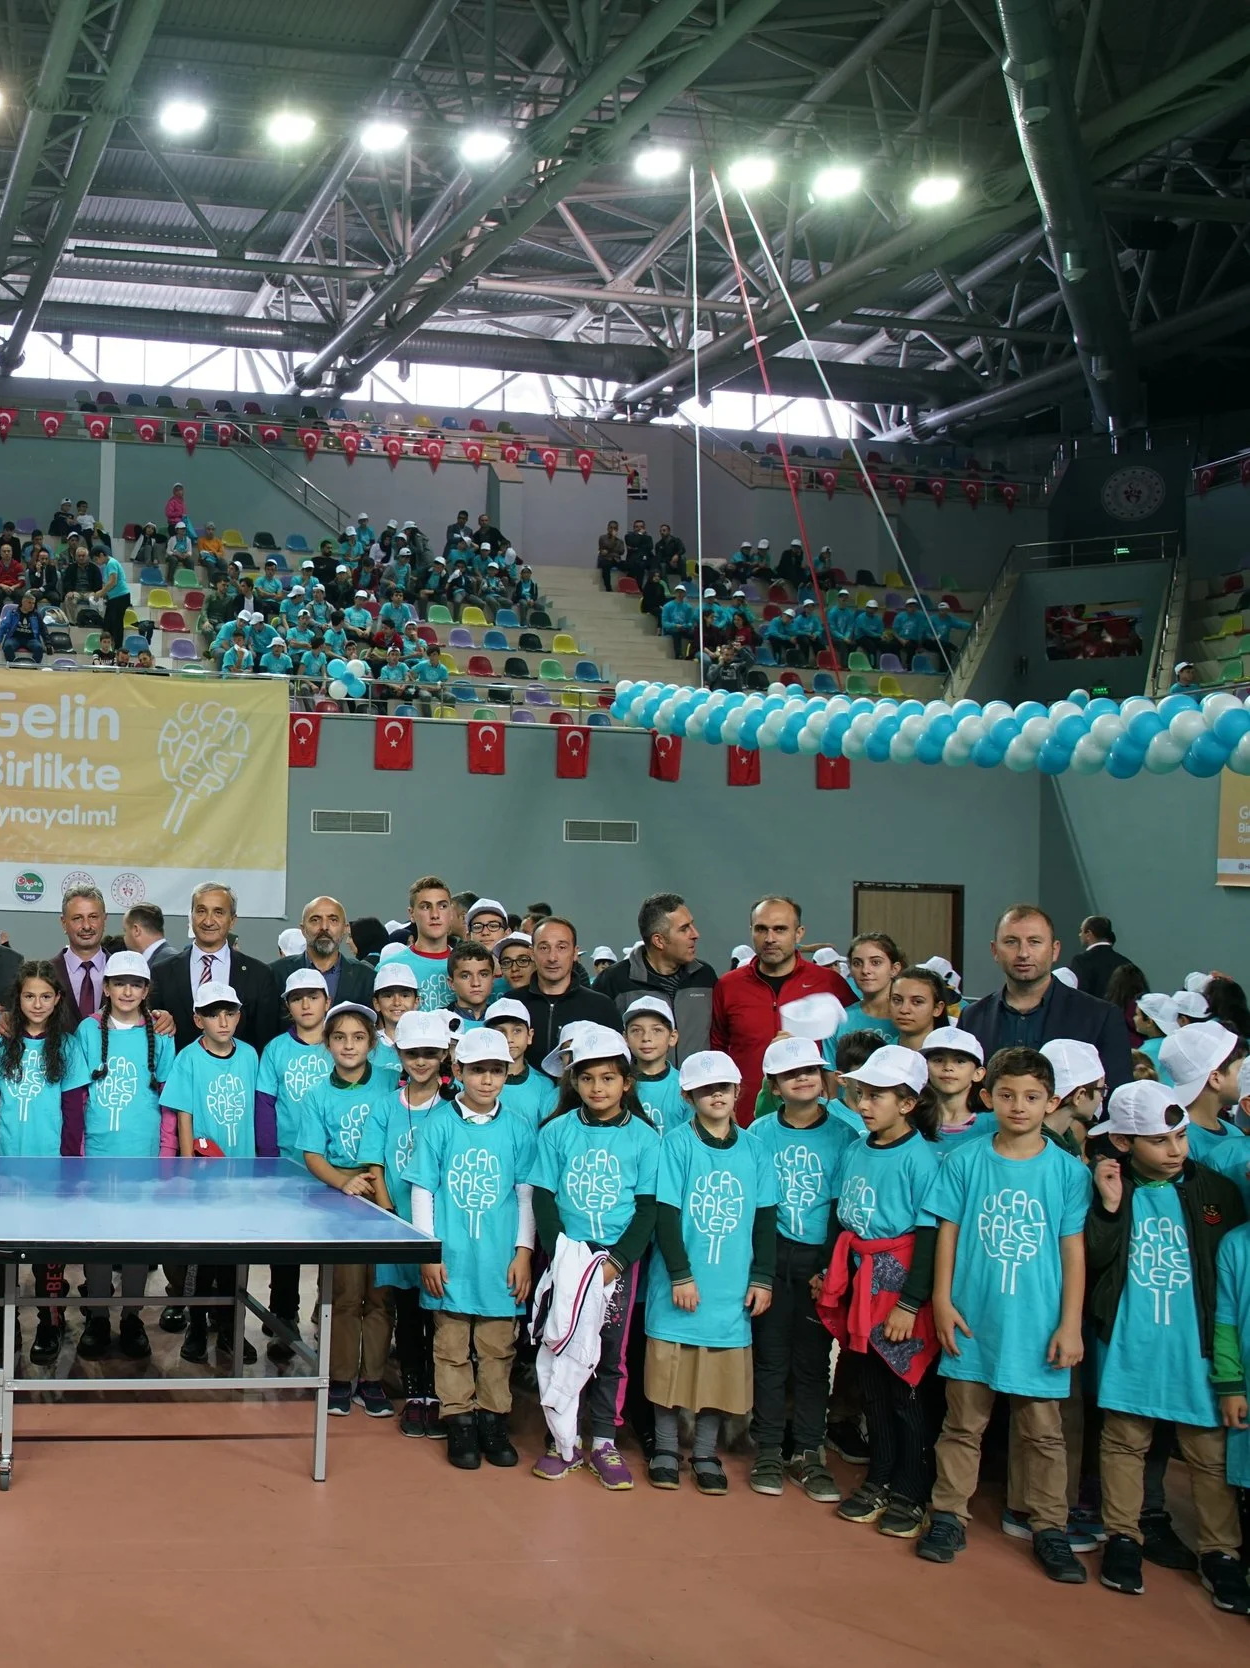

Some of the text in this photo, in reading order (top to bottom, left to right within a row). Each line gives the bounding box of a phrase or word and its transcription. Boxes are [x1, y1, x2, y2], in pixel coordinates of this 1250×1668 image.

[177, 700, 251, 751] UÇAN
[157, 719, 249, 783] RAKET
[288, 1054, 329, 1073] UÇAN
[208, 1072, 245, 1094] UÇAN
[206, 1090, 246, 1114] RAKET
[213, 1107, 243, 1125] LER
[452, 1148, 500, 1174] UÇAN
[572, 1148, 620, 1174] UÇAN
[448, 1170, 500, 1200] RAKET
[566, 1171, 622, 1201] RAKET
[695, 1170, 743, 1197] UÇAN
[452, 1192, 496, 1210] LER
[571, 1192, 618, 1210] LER
[690, 1192, 744, 1224] RAKET
[983, 1188, 1045, 1220] UÇAN
[693, 1216, 738, 1234] LER
[978, 1212, 1047, 1247] RAKET
[984, 1238, 1038, 1262] LER
[1130, 1267, 1191, 1289] LER
